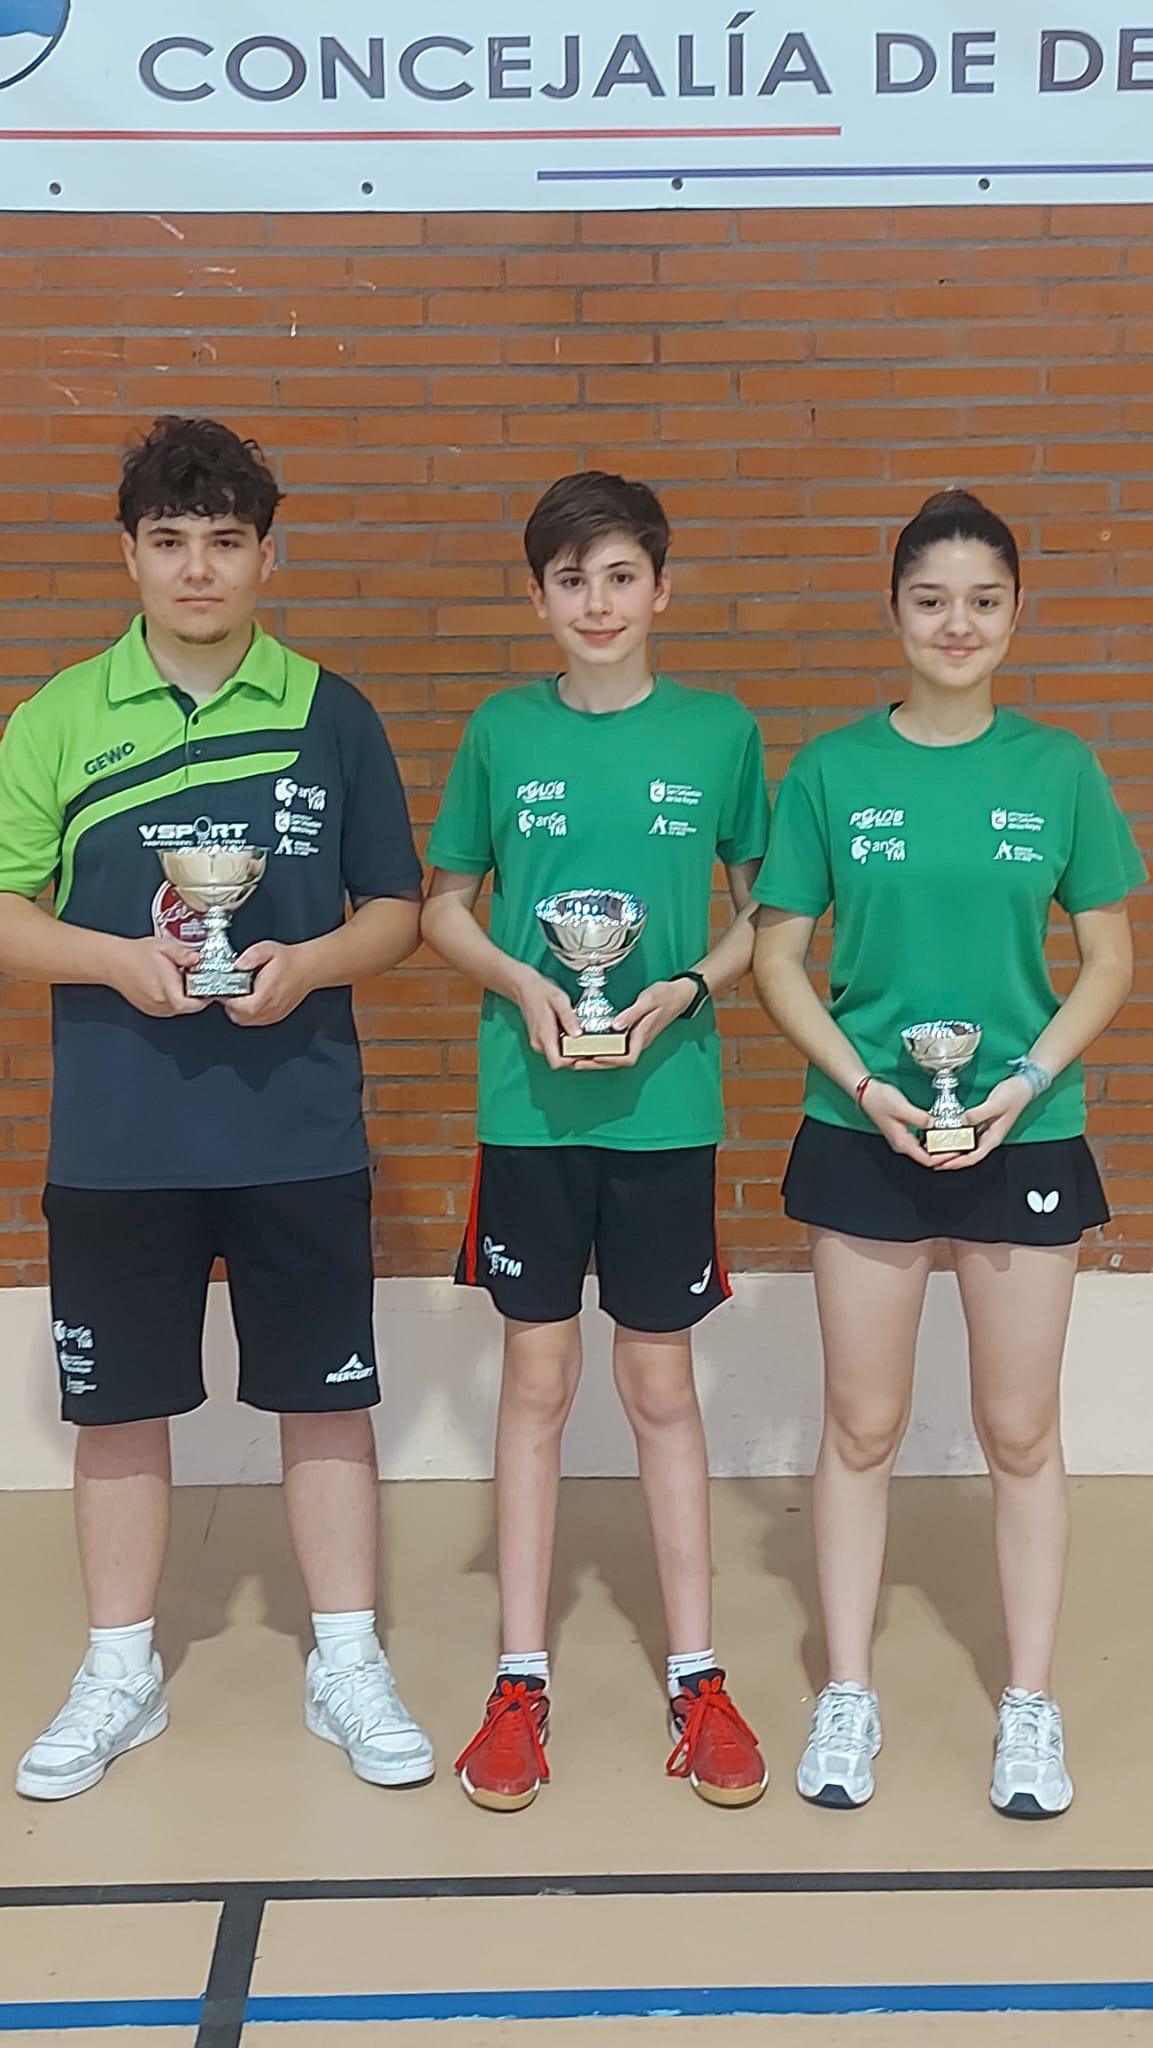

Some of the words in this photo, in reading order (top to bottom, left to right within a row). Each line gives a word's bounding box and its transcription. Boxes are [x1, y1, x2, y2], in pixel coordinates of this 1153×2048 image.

[138, 10, 832, 101] CONCEJALÍA
[875, 31, 996, 94] DE
[84, 741, 136, 775] GEWO
[138, 816, 249, 841] VSPORT
